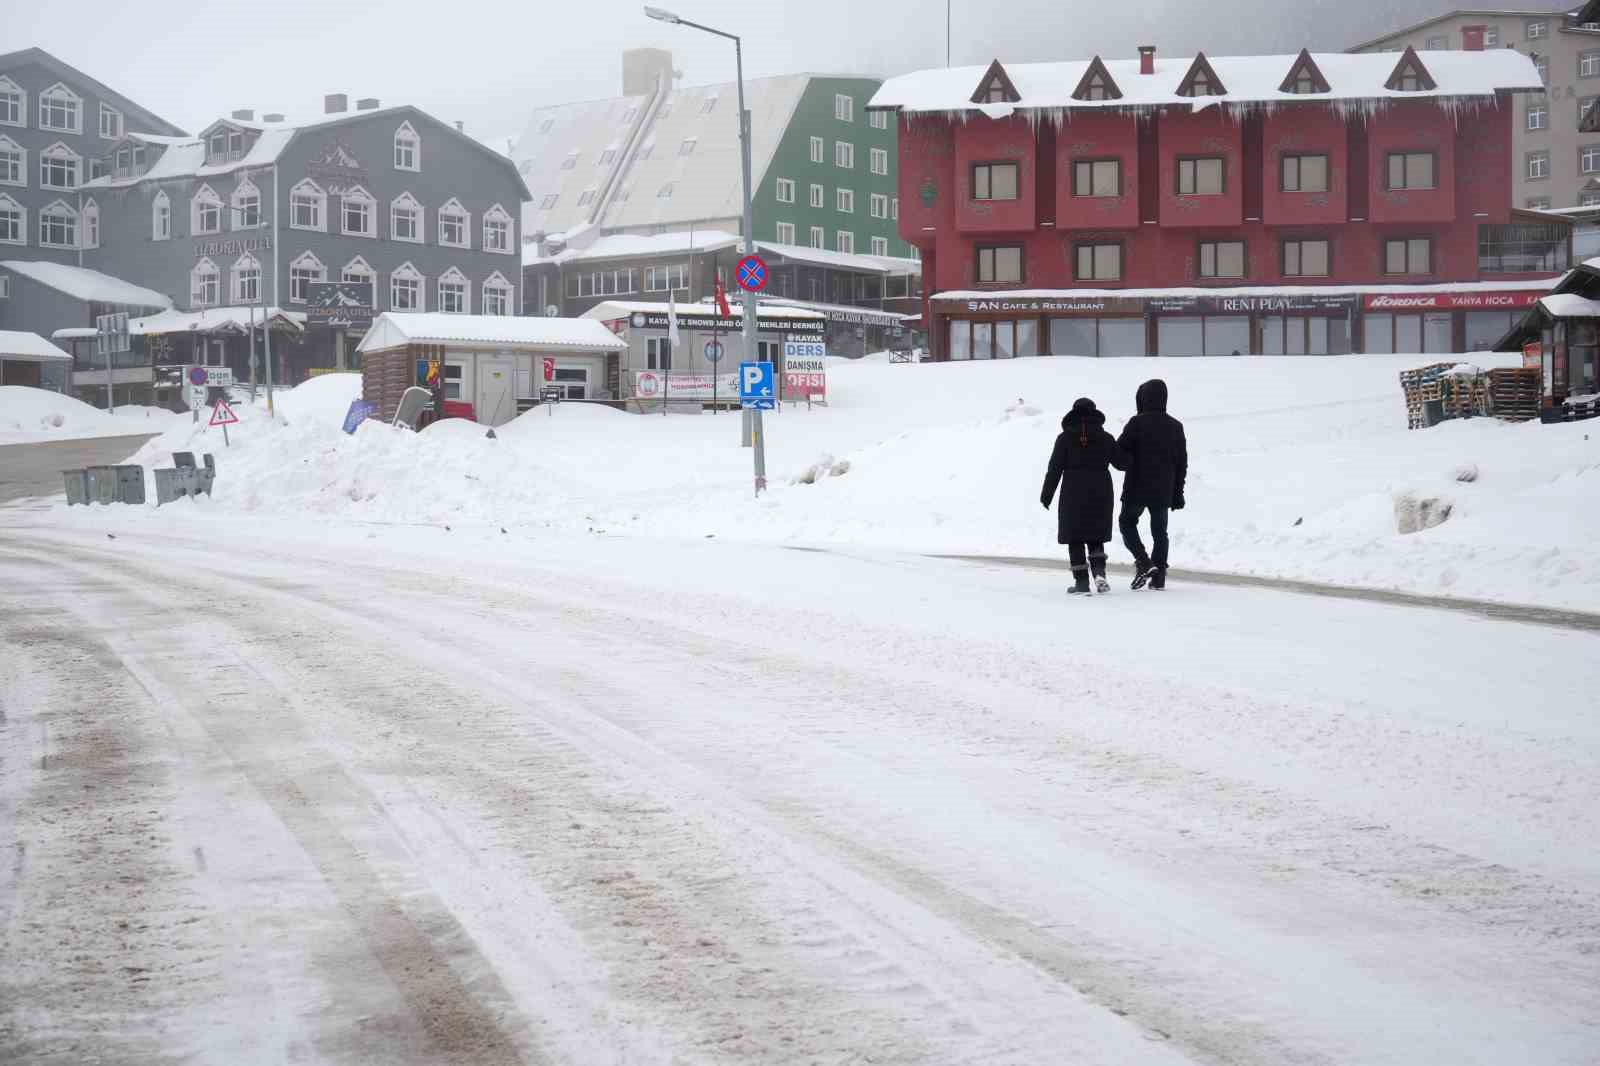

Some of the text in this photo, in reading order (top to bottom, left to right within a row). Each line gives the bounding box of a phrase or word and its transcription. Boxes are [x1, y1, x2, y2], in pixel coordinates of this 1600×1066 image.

[1223, 297, 1291, 311] RENT PLAY
[1451, 297, 1482, 305] YAHYA
[1485, 296, 1514, 305] HOCA
[787, 344, 823, 356] DERS
[743, 366, 763, 394] P
